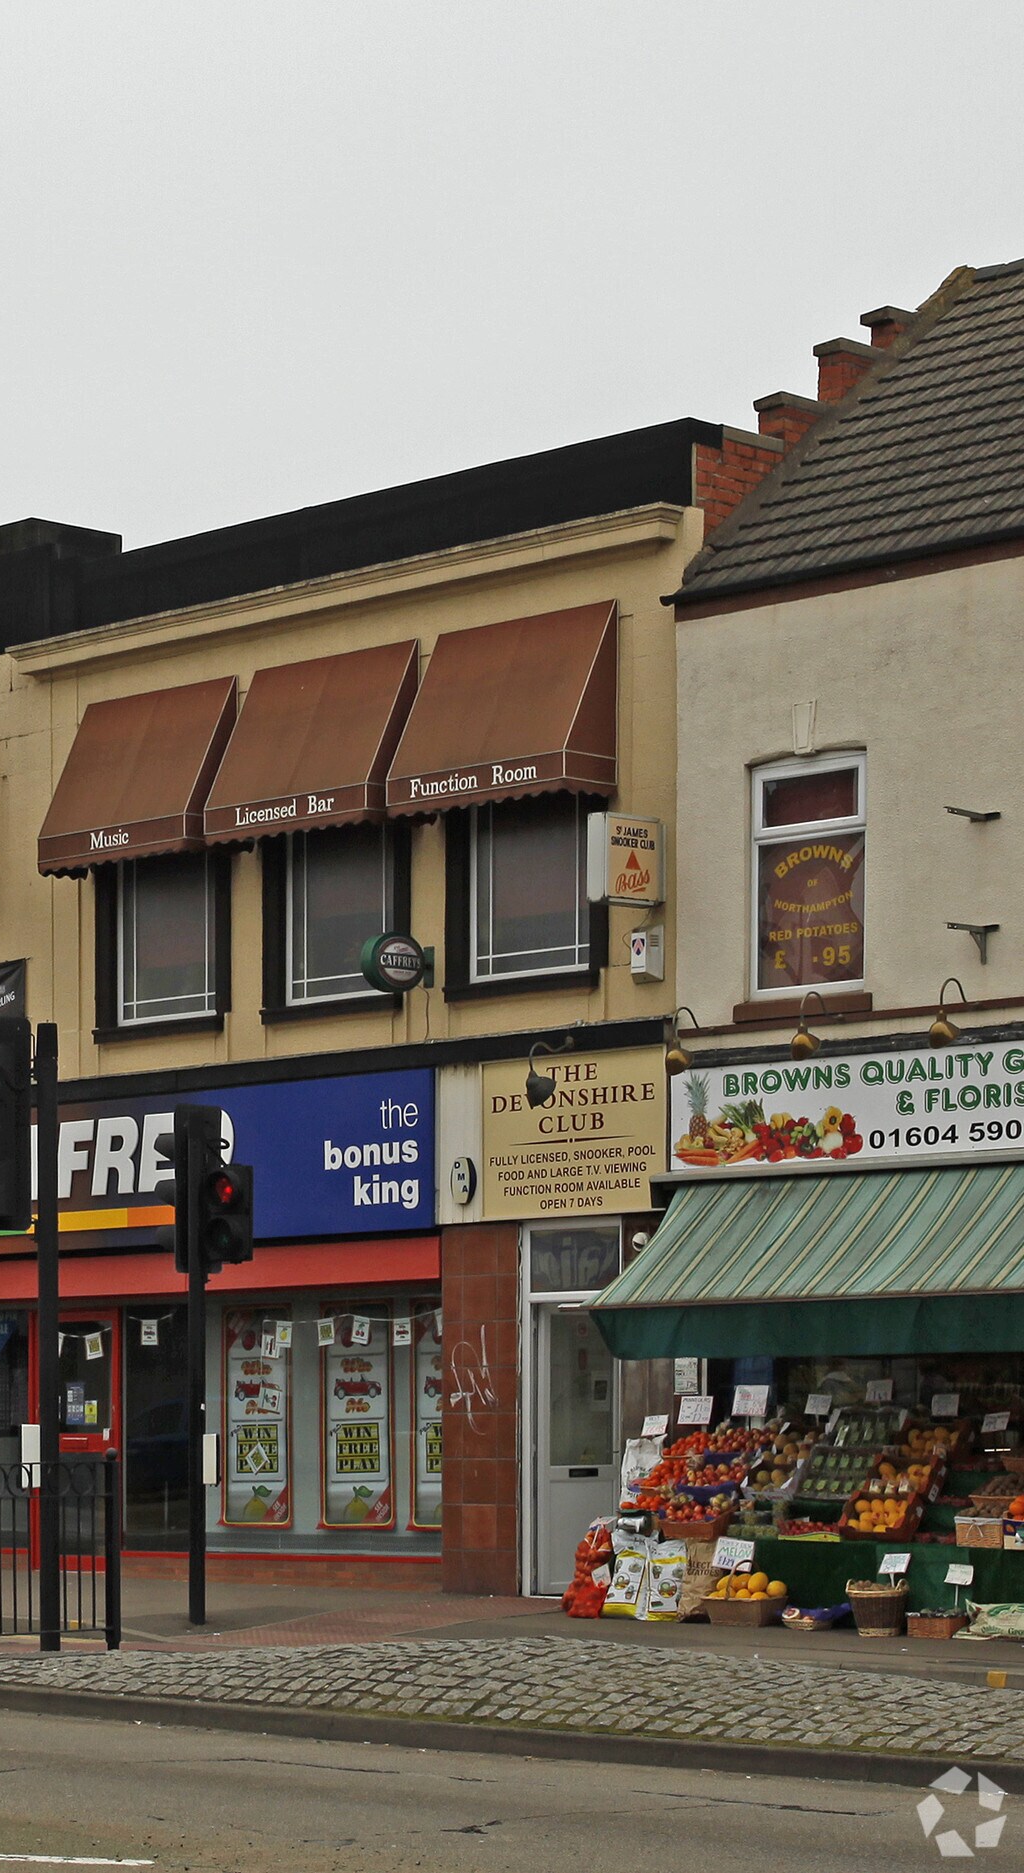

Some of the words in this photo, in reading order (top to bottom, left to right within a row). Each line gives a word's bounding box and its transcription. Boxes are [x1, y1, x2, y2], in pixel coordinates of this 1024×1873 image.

[409, 773, 478, 799] Function
[491, 763, 538, 786] Room
[235, 799, 297, 828] Licensed
[307, 795, 335, 815] Bar
[89, 829, 130, 851] Music
[610, 836, 639, 849] SNOOKER
[639, 839, 656, 851] CLUB
[623, 826, 649, 839] JAMES
[773, 844, 854, 878] BROWNS
[614, 868, 651, 894] Bass
[807, 878, 819, 888] OF
[773, 889, 855, 914] NORTHAMPTON
[768, 930, 792, 942] RED
[796, 922, 859, 939] POTATOES
[545, 1062, 599, 1084] THE
[722, 1062, 852, 1098] BROWNS
[859, 1050, 994, 1087] QUALITY
[379, 1097, 419, 1130] the
[894, 1089, 916, 1117] &
[537, 1111, 606, 1135] CLUB
[868, 1123, 960, 1151] 01604
[323, 1138, 419, 1171] bonus
[489, 1155, 519, 1168] FULLY
[520, 1151, 571, 1166] LICENSED,
[573, 1147, 626, 1162] SNOOKER,
[627, 1144, 657, 1157] POOL
[497, 1170, 525, 1182] FOOD
[526, 1168, 548, 1180] AND
[550, 1165, 584, 1178] LARGE
[585, 1164, 602, 1176] T.V.
[604, 1160, 648, 1175] VIEWING
[352, 1174, 421, 1209] king
[503, 1183, 553, 1197] FUNCTION
[554, 1180, 585, 1194] ROOM
[586, 1177, 641, 1192] AVAILABLE
[539, 1198, 567, 1210] OPEN
[569, 1197, 575, 1208] 7
[577, 1195, 604, 1208] DAYS
[242, 1427, 272, 1439] WIN
[342, 1425, 373, 1439] WIN
[338, 1442, 378, 1455] FREE
[338, 1458, 377, 1471] PLAY
[718, 1546, 752, 1558] MELON
